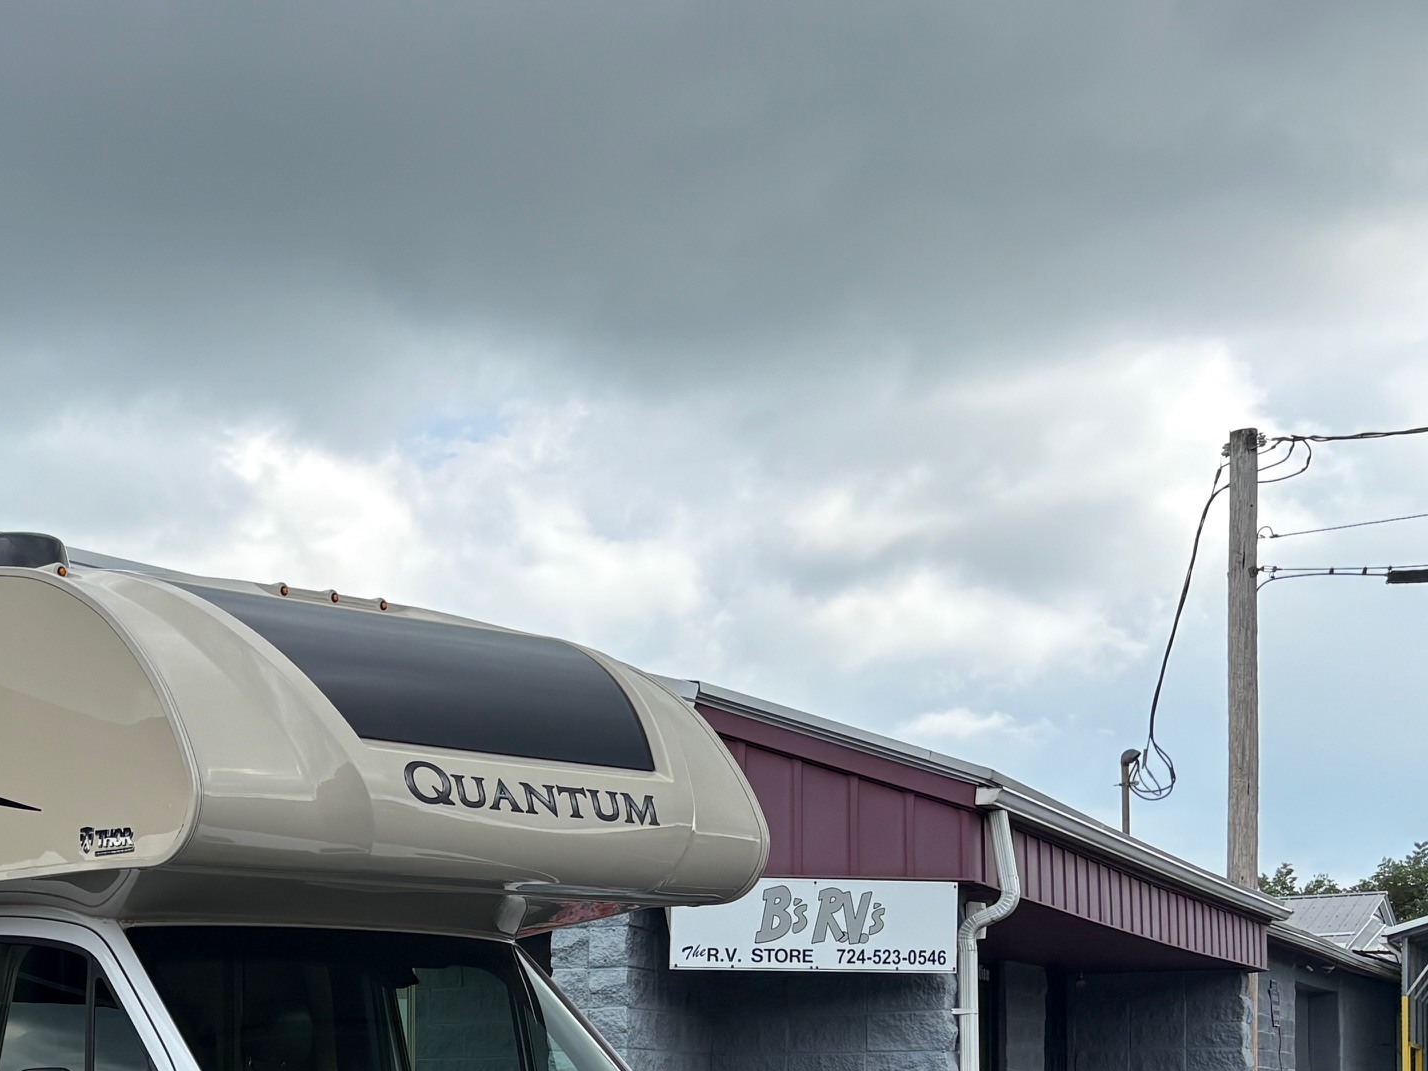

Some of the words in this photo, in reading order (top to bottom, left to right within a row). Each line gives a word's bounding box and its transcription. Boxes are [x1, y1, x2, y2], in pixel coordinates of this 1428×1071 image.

[404, 760, 660, 826] QUANTUM
[95, 827, 134, 848] THOR
[751, 948, 814, 963] STORE
[836, 948, 946, 965] 724-523-0546
